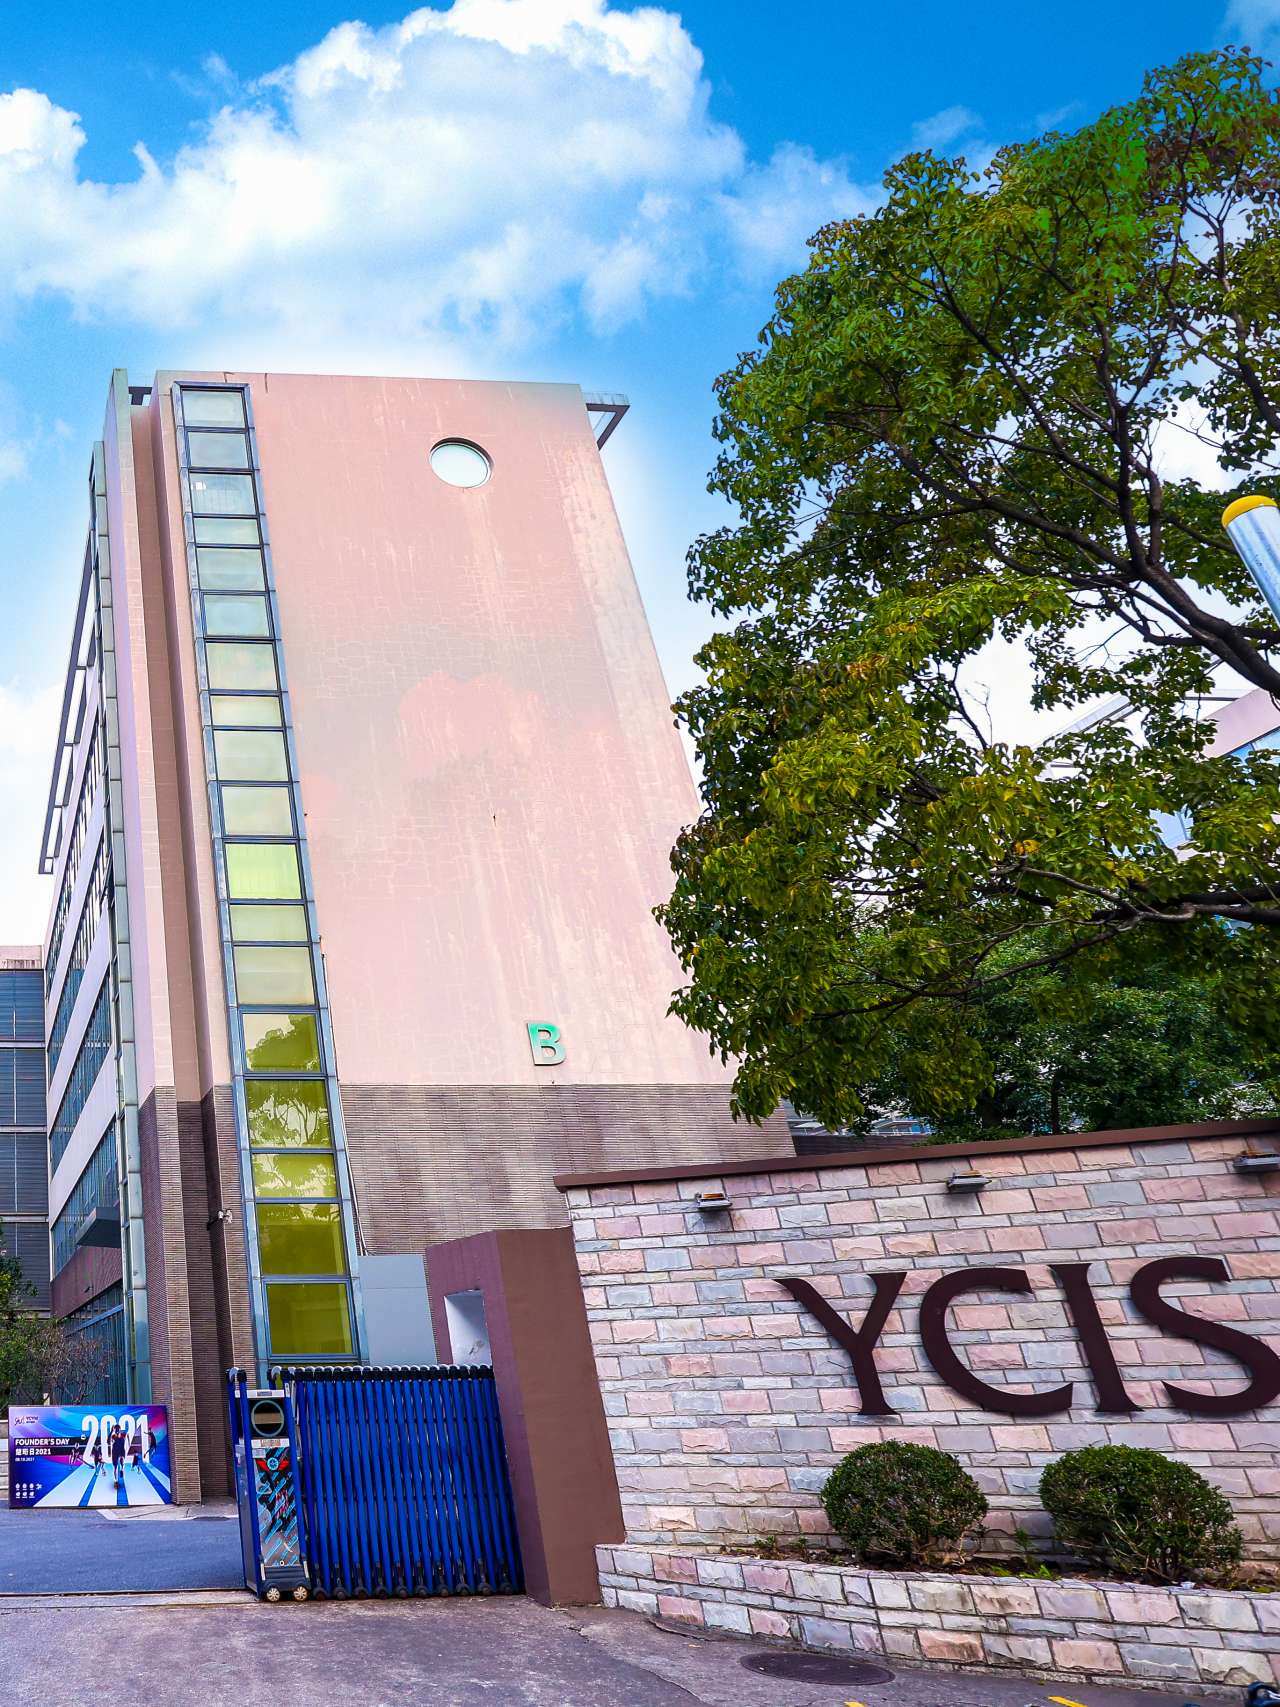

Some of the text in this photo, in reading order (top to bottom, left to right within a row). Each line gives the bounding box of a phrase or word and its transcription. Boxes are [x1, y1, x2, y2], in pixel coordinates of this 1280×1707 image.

[526, 1022, 566, 1066] B
[773, 1256, 1280, 1416] YCIS
[15, 1438, 70, 1446] FOUNDER'S DAY
[81, 1414, 150, 1464] 2021
